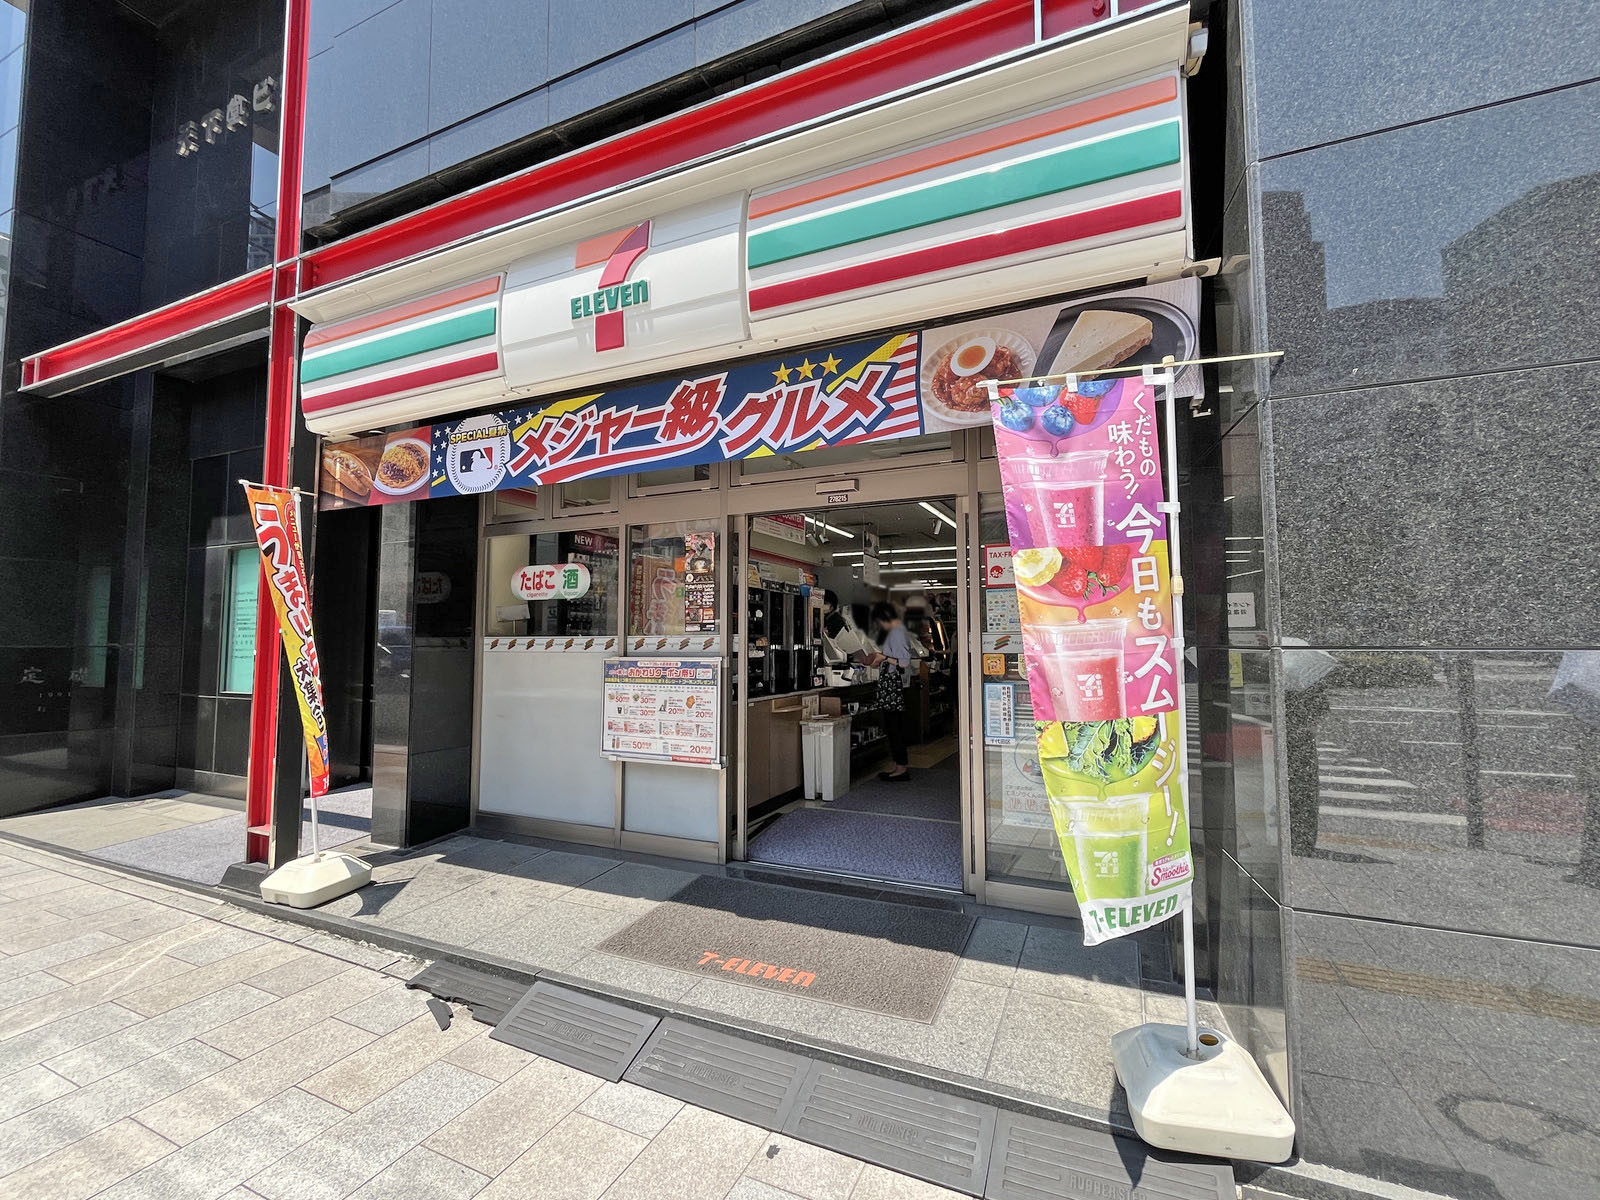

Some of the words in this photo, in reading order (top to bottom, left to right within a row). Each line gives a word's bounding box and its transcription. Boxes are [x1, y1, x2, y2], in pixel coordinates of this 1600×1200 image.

[570, 280, 649, 319] ELEVEN
[1131, 391, 1156, 477] くだもの
[1107, 422, 1141, 500] 味わう!
[574, 534, 593, 546] NEW
[520, 569, 556, 592] たばこ
[562, 568, 579, 590] 酒
[1114, 502, 1180, 847] 今日もスムージー!
[1151, 865, 1190, 887] Smoothie
[1088, 893, 1179, 934] 7-ELEVEN
[696, 950, 817, 988] 7-ELEVEN
